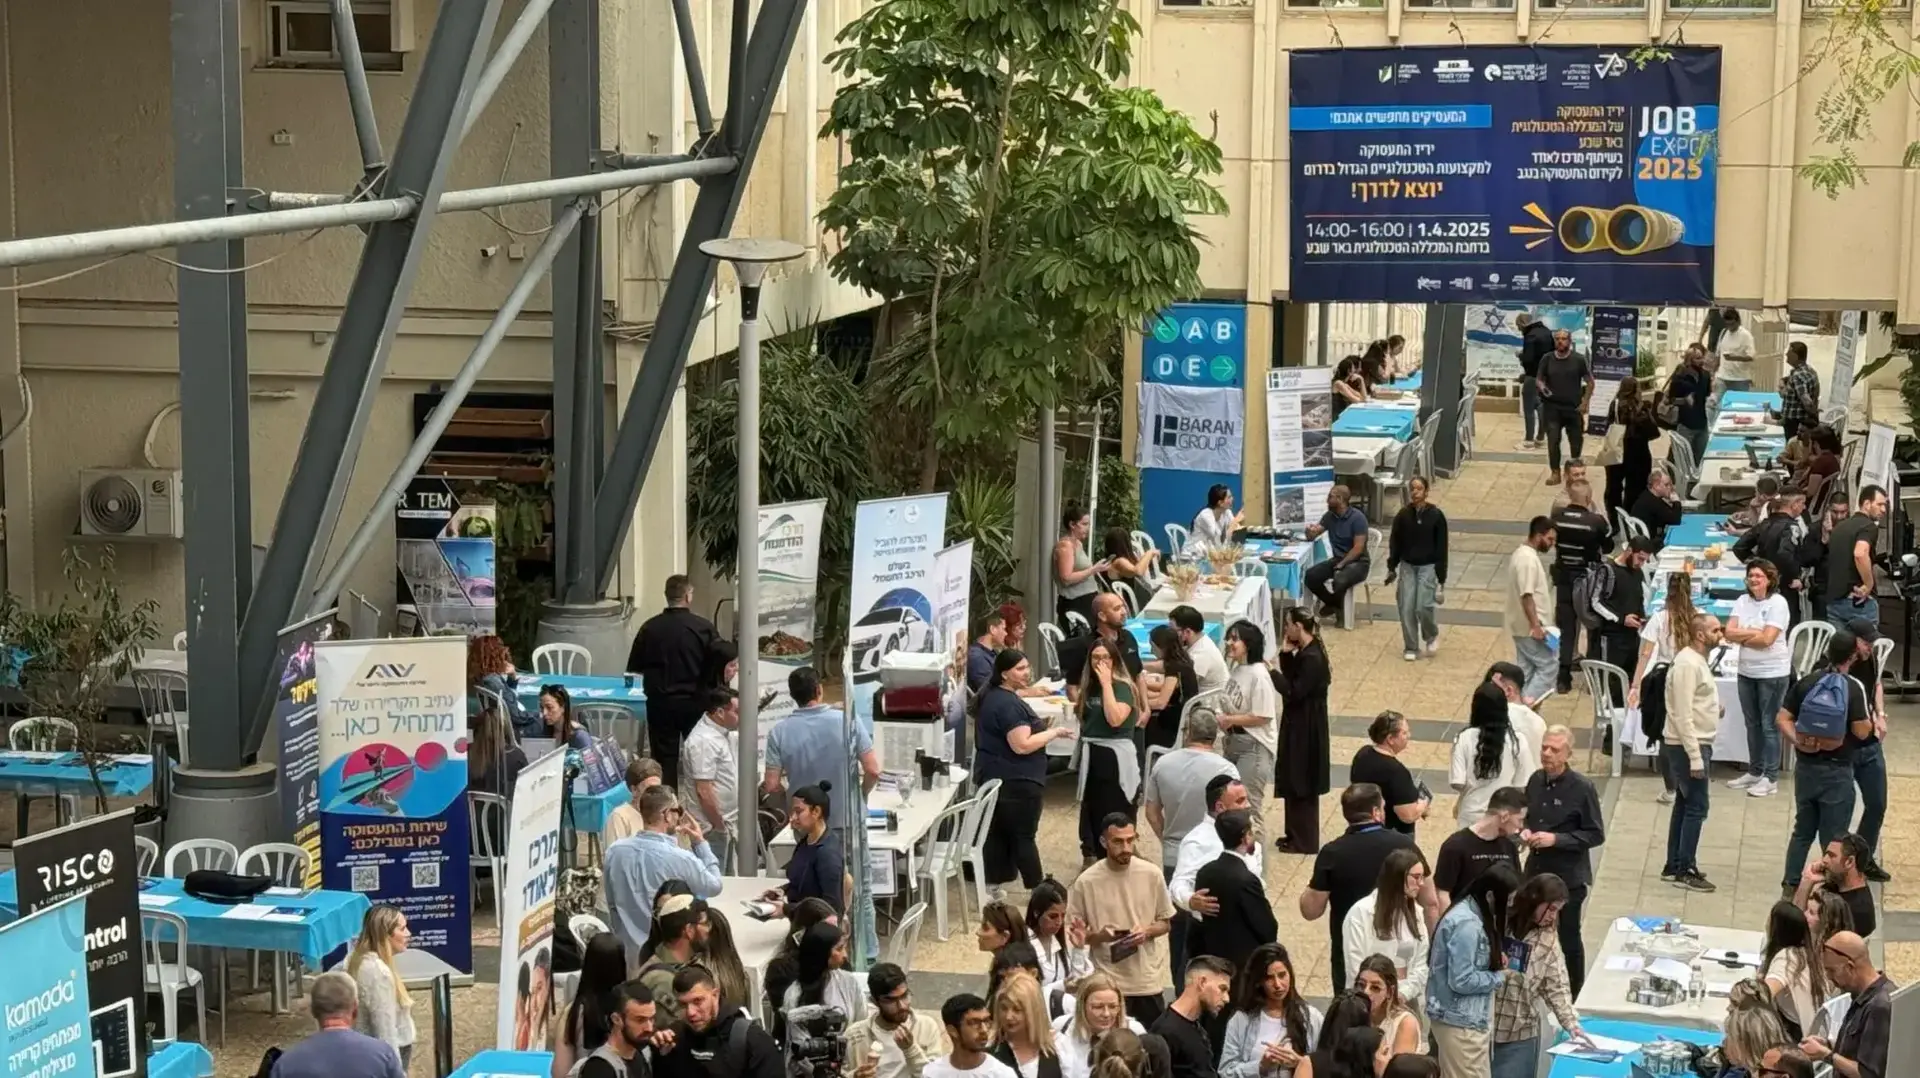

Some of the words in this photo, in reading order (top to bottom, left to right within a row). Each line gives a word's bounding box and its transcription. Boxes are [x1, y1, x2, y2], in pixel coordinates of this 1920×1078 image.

[1330, 112, 1363, 124] אתכם!
[1365, 112, 1410, 124] מחפשים
[1412, 111, 1466, 126] המעסיקים
[1556, 106, 1604, 119] התעסוקה
[1606, 106, 1625, 117] יריד
[1511, 120, 1565, 133] הטכנולוגית
[1566, 119, 1606, 133] המכללה
[1608, 119, 1624, 133] של
[1638, 106, 1696, 137] JOB
[1414, 144, 1435, 156] יריד
[1579, 137, 1602, 149] שבע
[1604, 137, 1624, 148] באר
[1359, 144, 1412, 159] התעסוקה
[1531, 150, 1560, 164] לאודר
[1561, 152, 1584, 164] מרכז
[1586, 152, 1623, 166] בשיתוף
[1303, 164, 1335, 177] בדרום
[1337, 162, 1368, 176] הגדול
[1370, 161, 1434, 177] הטכנולוגיים
[1436, 160, 1492, 178] למקצועות
[1517, 167, 1539, 180] בנגב
[1540, 167, 1587, 182] התעסוקה
[1589, 166, 1623, 182] לקידום
[1638, 157, 1702, 180] 2025
[1351, 178, 1400, 203] לדרך!
[1404, 181, 1443, 199] יוצא
[1305, 222, 1405, 239] 14:00-16:00
[1417, 221, 1490, 237] 1.4.2025
[1306, 242, 1329, 255] שבע
[1332, 242, 1352, 254] באר
[1353, 240, 1410, 255] הטכנולוגית
[1411, 240, 1453, 254] המכללה
[1455, 241, 1490, 254] ברחבת
[1188, 321, 1203, 339] A
[1217, 322, 1231, 339] B
[1159, 359, 1173, 375] D
[1188, 360, 1200, 377] E
[1180, 416, 1235, 436] BARAN
[1178, 434, 1227, 451] GROUP
[416, 492, 451, 509] TEM
[330, 697, 360, 716] שלך
[364, 696, 420, 712] הקריירה
[424, 695, 454, 708] נתיב
[330, 717, 380, 742] כאן...
[387, 711, 454, 733] מתחיל
[343, 823, 405, 838] התעסוקה
[409, 821, 447, 833] שירות
[351, 836, 415, 849] בשבילכם:
[418, 835, 440, 848] כאן
[528, 830, 558, 870] מרכז
[37, 848, 114, 892] RISCO
[84, 916, 127, 953] ntrol
[5, 980, 75, 1031] kamada
